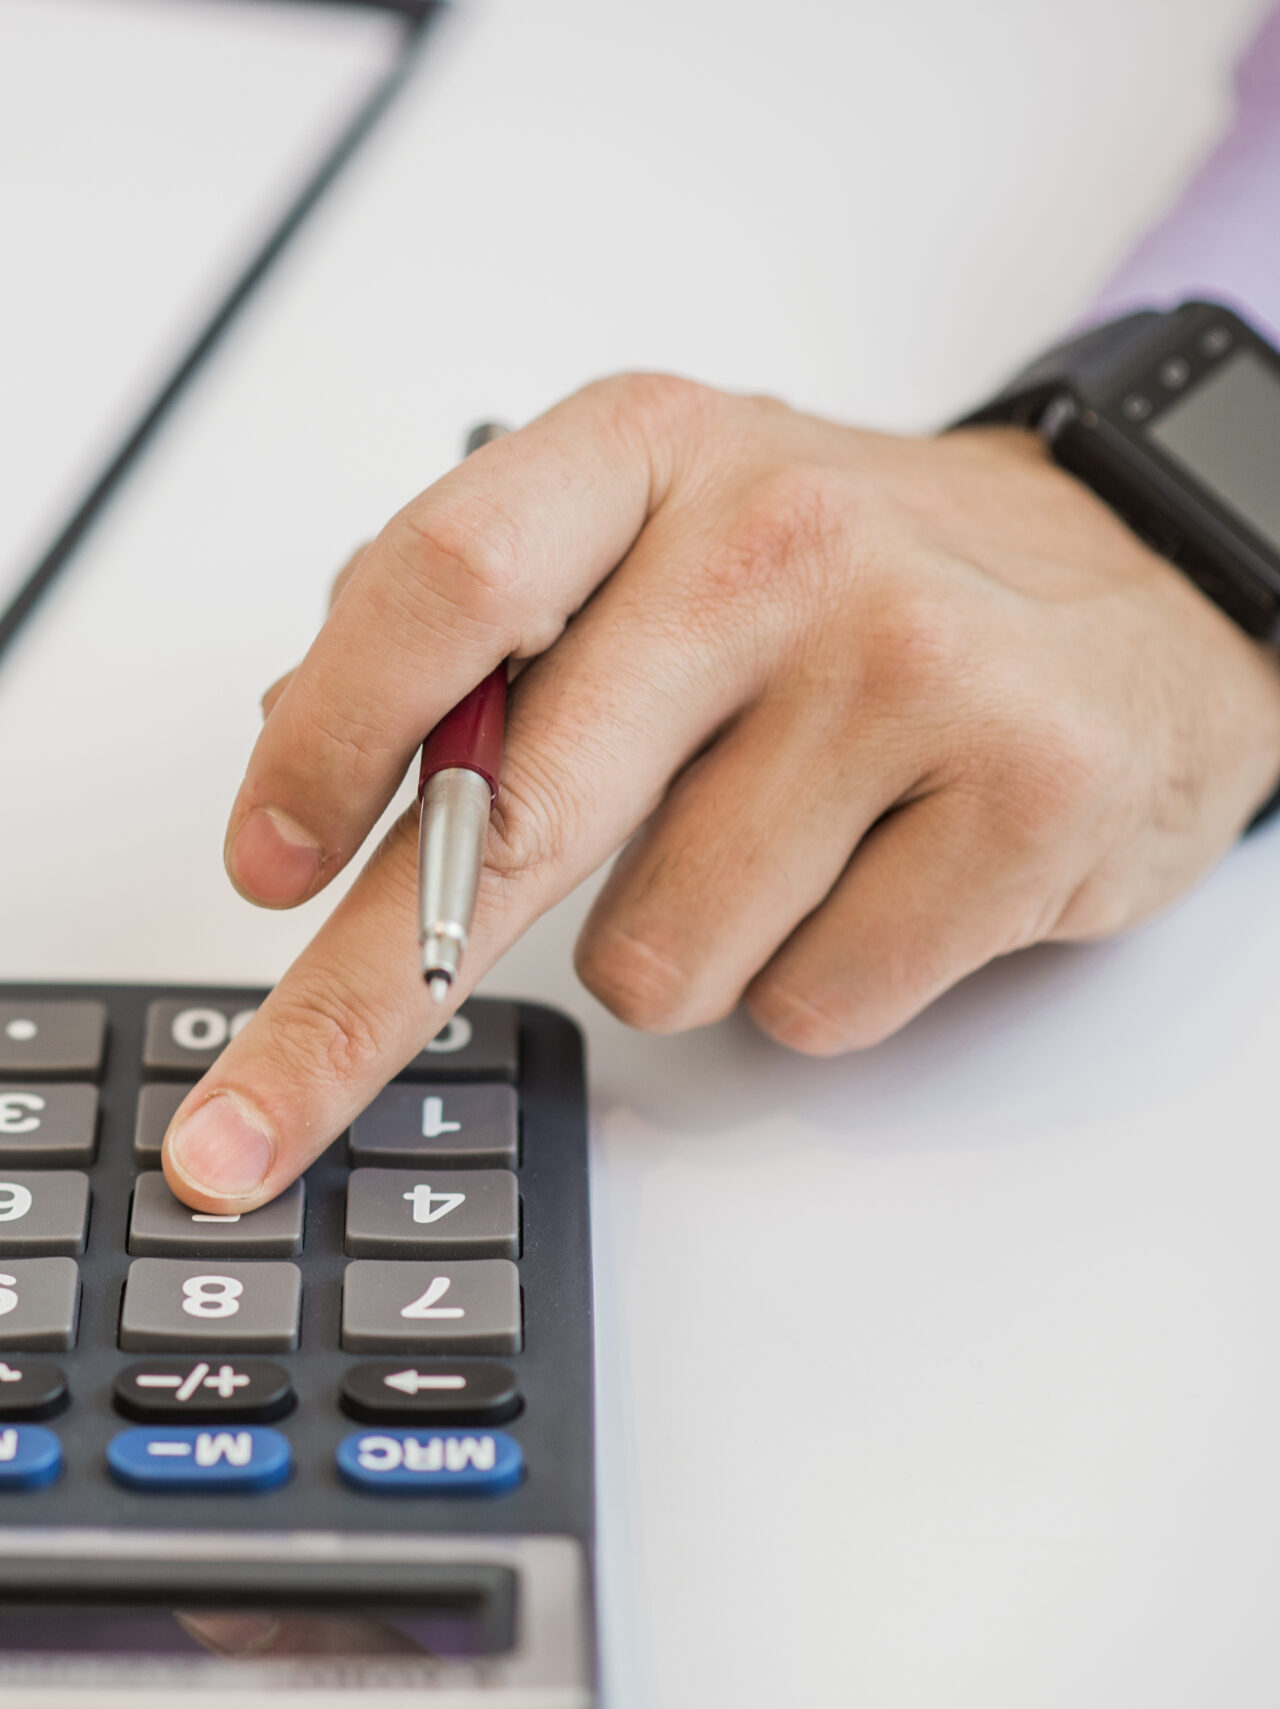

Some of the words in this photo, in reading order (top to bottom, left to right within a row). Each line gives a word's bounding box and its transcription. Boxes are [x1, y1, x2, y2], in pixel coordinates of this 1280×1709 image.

[422, 1096, 461, 1137] 1
[403, 1184, 466, 1224] 4
[182, 1274, 244, 1318] 8
[400, 1276, 465, 1320] 7
[358, 1436, 496, 1472] MRC
